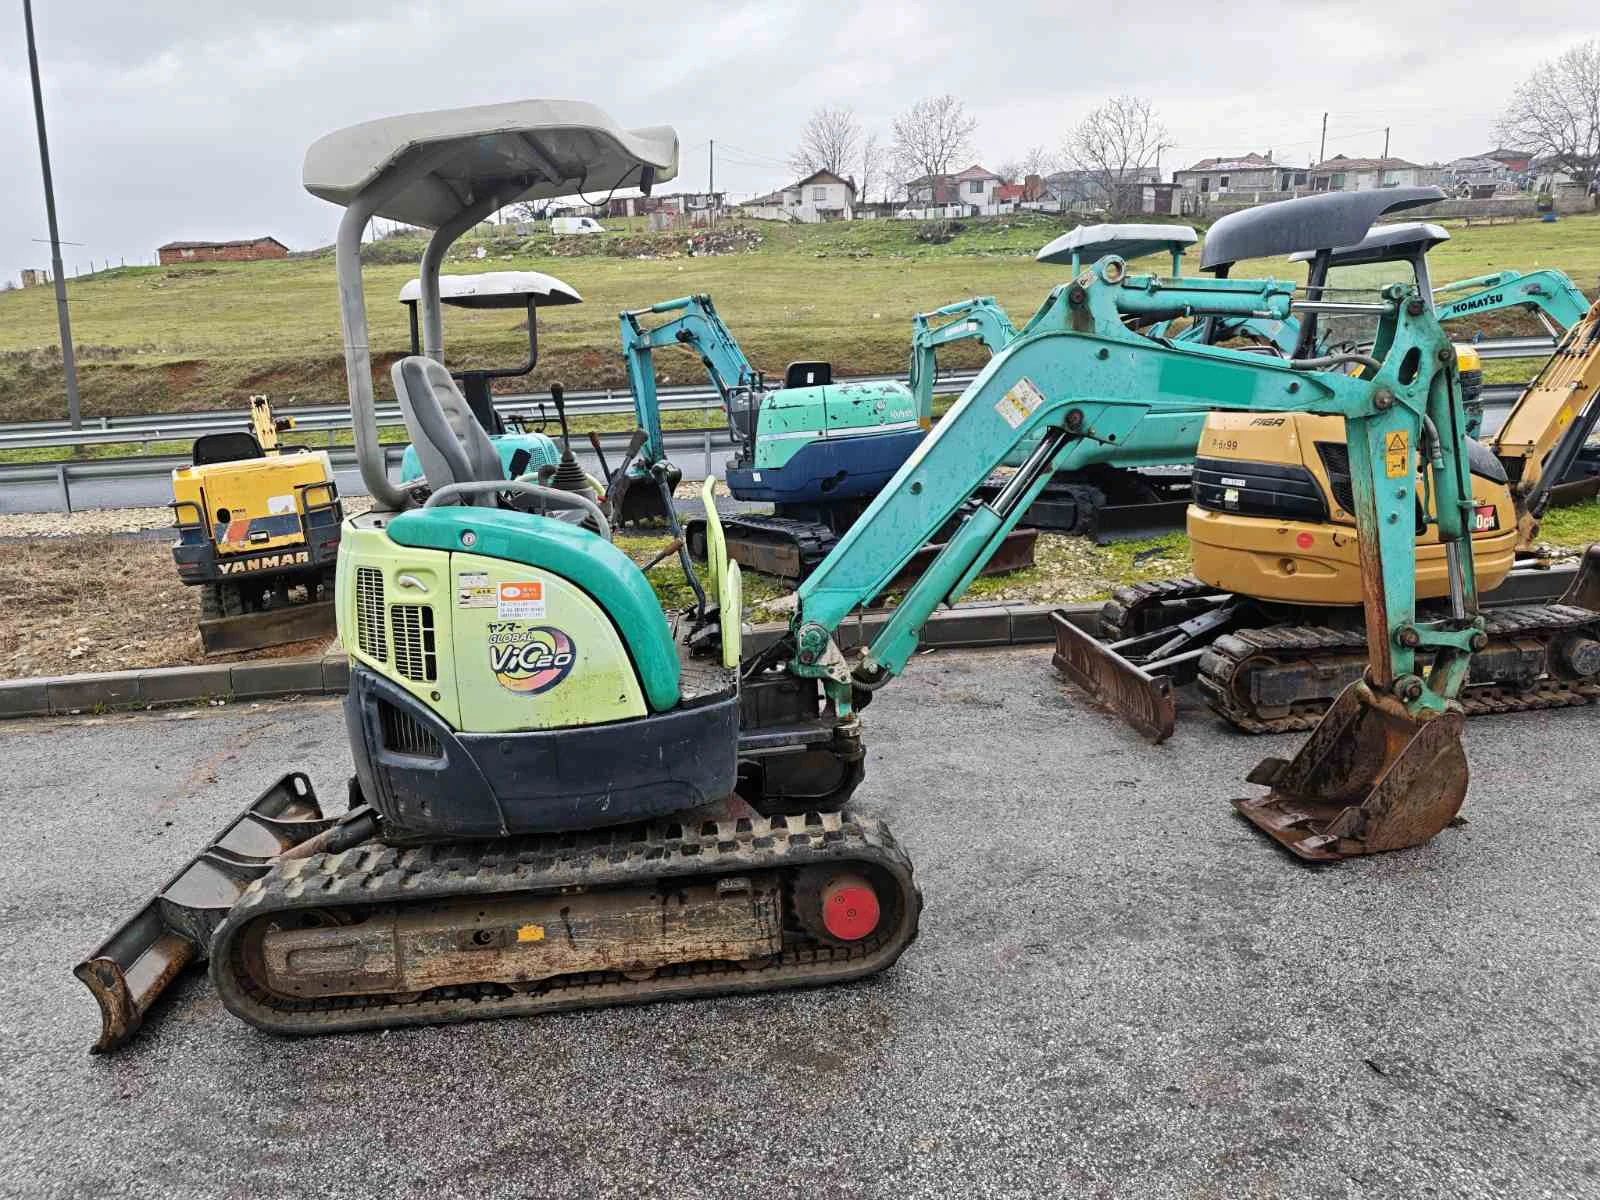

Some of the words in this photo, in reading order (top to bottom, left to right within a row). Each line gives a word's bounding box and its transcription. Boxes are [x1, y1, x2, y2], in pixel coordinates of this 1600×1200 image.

[1453, 294, 1503, 313] KOMATSU
[217, 552, 309, 575] YANMAR
[488, 623, 522, 633] ヤンマー
[489, 632, 534, 644] GLOBAL
